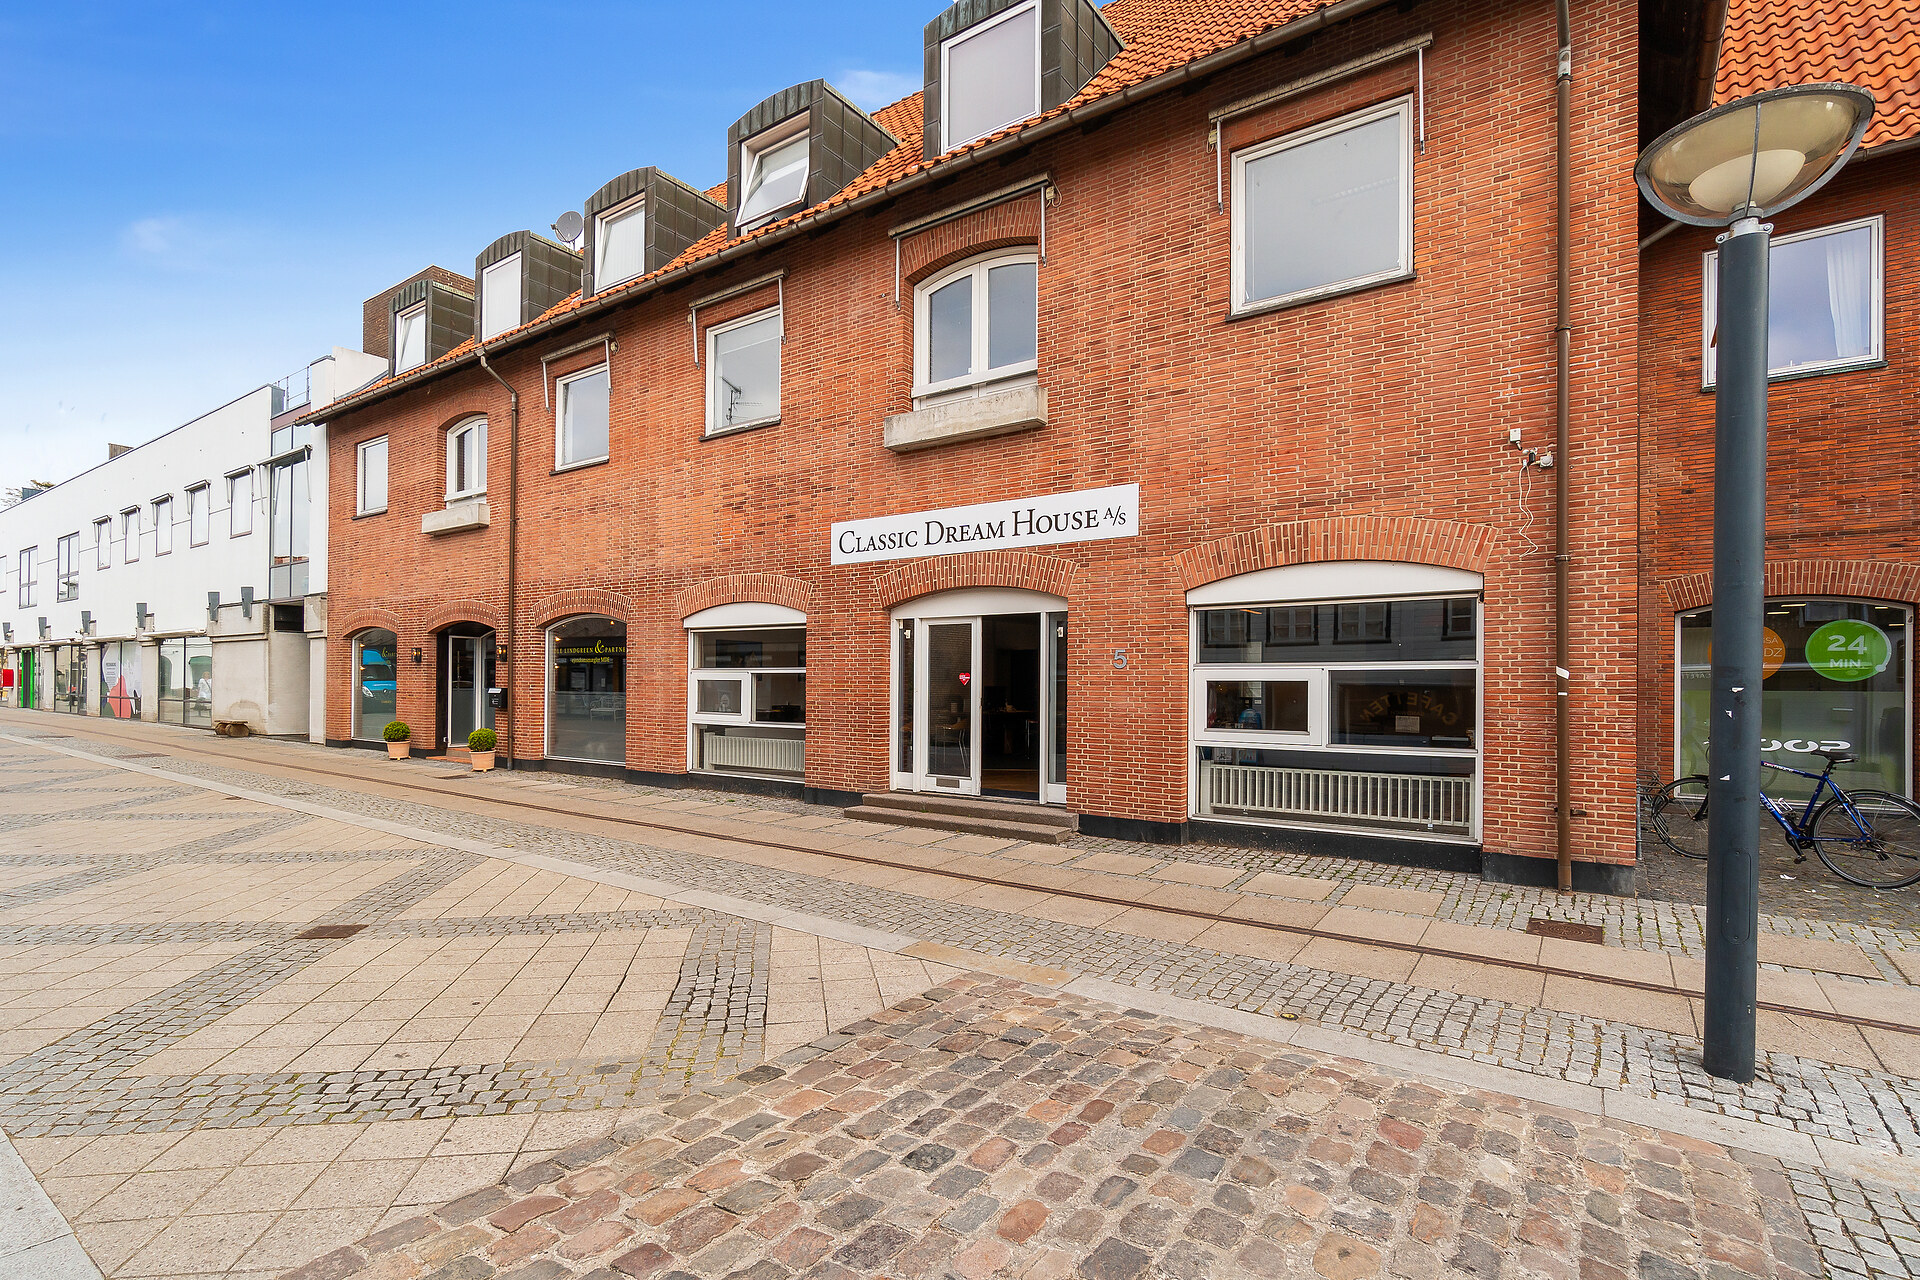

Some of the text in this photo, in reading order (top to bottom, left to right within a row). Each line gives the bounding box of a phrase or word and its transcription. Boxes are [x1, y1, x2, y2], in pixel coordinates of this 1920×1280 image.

[839, 530, 918, 554] CLASSIC
[925, 520, 1006, 546] DREAM
[1012, 508, 1100, 537] HOUSE
[594, 639, 606, 654] &
[1827, 634, 1868, 655] 24
[1113, 649, 1128, 669] 5
[1761, 739, 1851, 752] OOP
